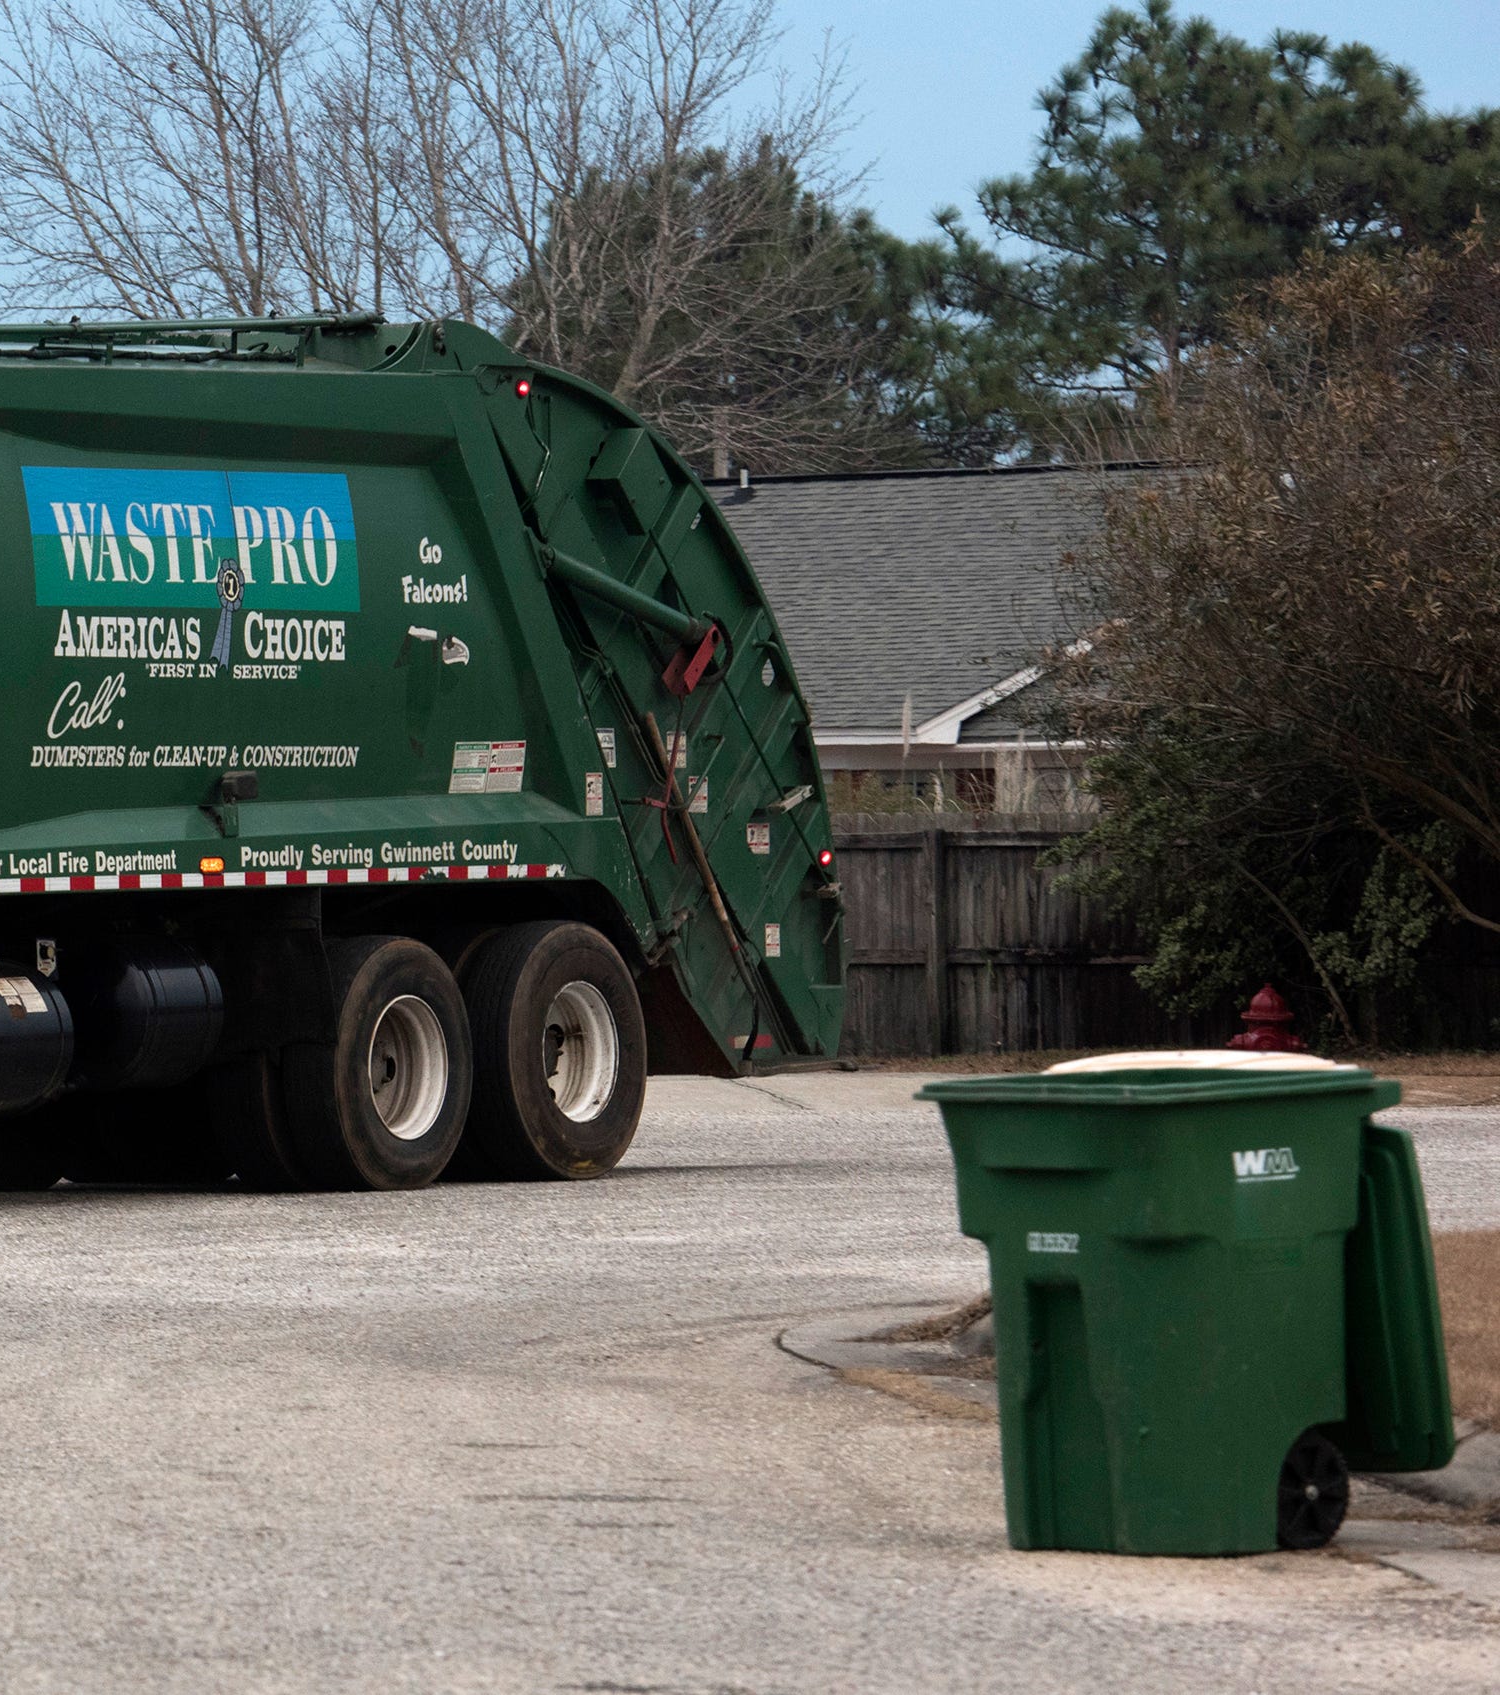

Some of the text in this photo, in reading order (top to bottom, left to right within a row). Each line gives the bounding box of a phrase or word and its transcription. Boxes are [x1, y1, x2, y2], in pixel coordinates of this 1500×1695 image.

[50, 502, 338, 587] WASTE PRO
[419, 536, 443, 564] Go
[401, 574, 468, 604] Falcons!
[54, 608, 346, 661] AMERICA'S CHOICE
[199, 664, 217, 678] IN
[30, 745, 360, 768] DUMPSTERS for CLEAN-UP & CONSTRUCTION
[9, 852, 52, 875] Local
[59, 850, 89, 874] Fire
[95, 849, 177, 876] Department
[240, 838, 518, 870] Proudly Serving Gwinnett County
[1232, 1147, 1300, 1176] WM
